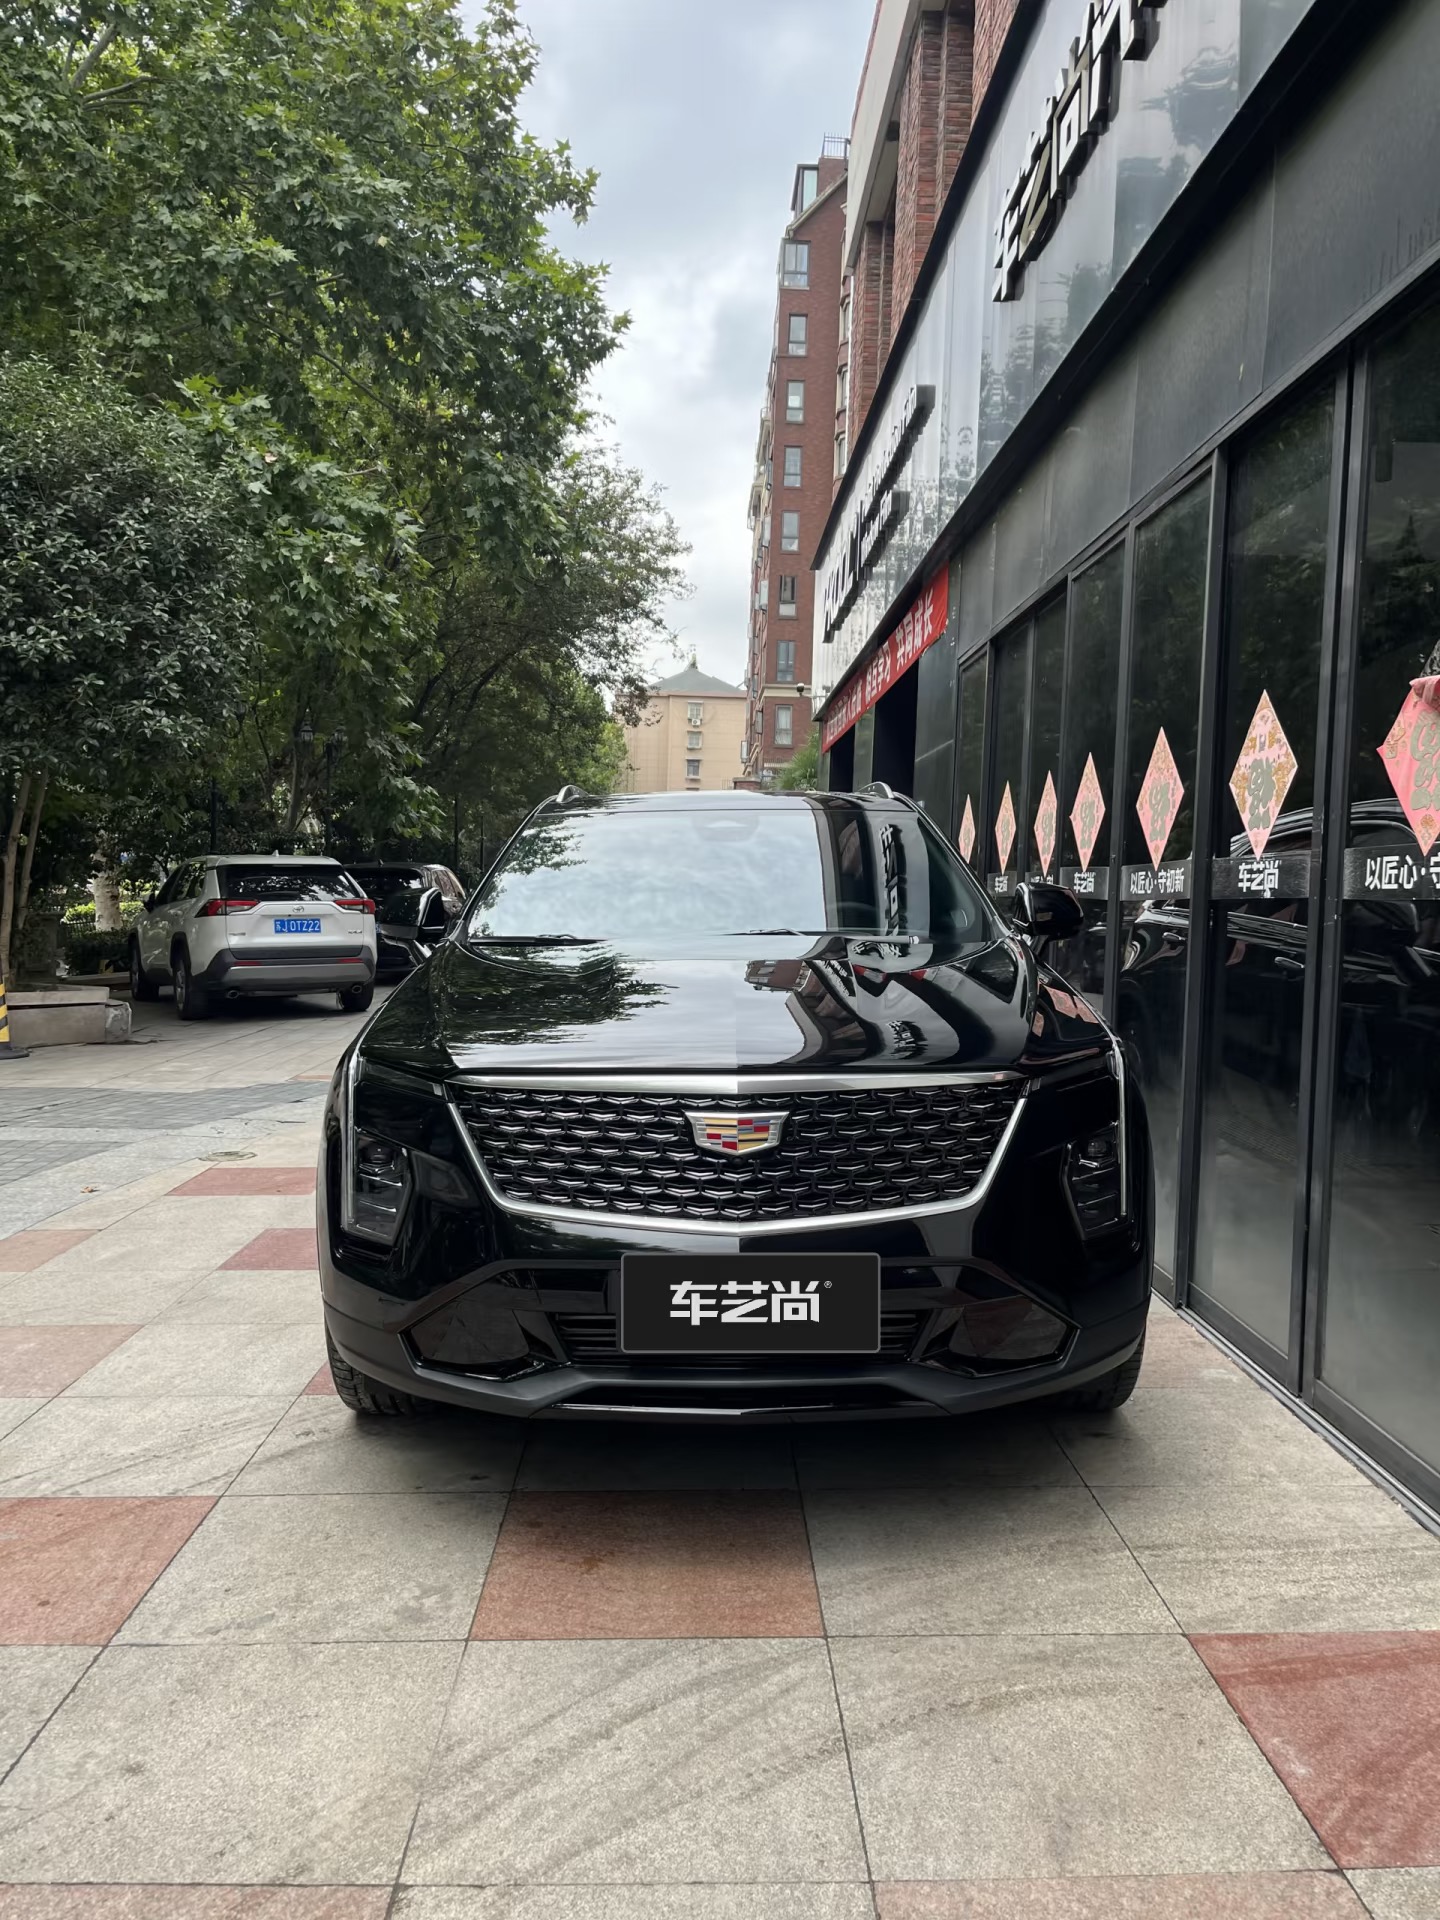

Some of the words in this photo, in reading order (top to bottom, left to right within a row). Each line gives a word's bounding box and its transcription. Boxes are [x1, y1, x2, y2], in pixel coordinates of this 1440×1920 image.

[895, 588, 934, 671] 共同成长
[1237, 860, 1282, 893] 车艺尚
